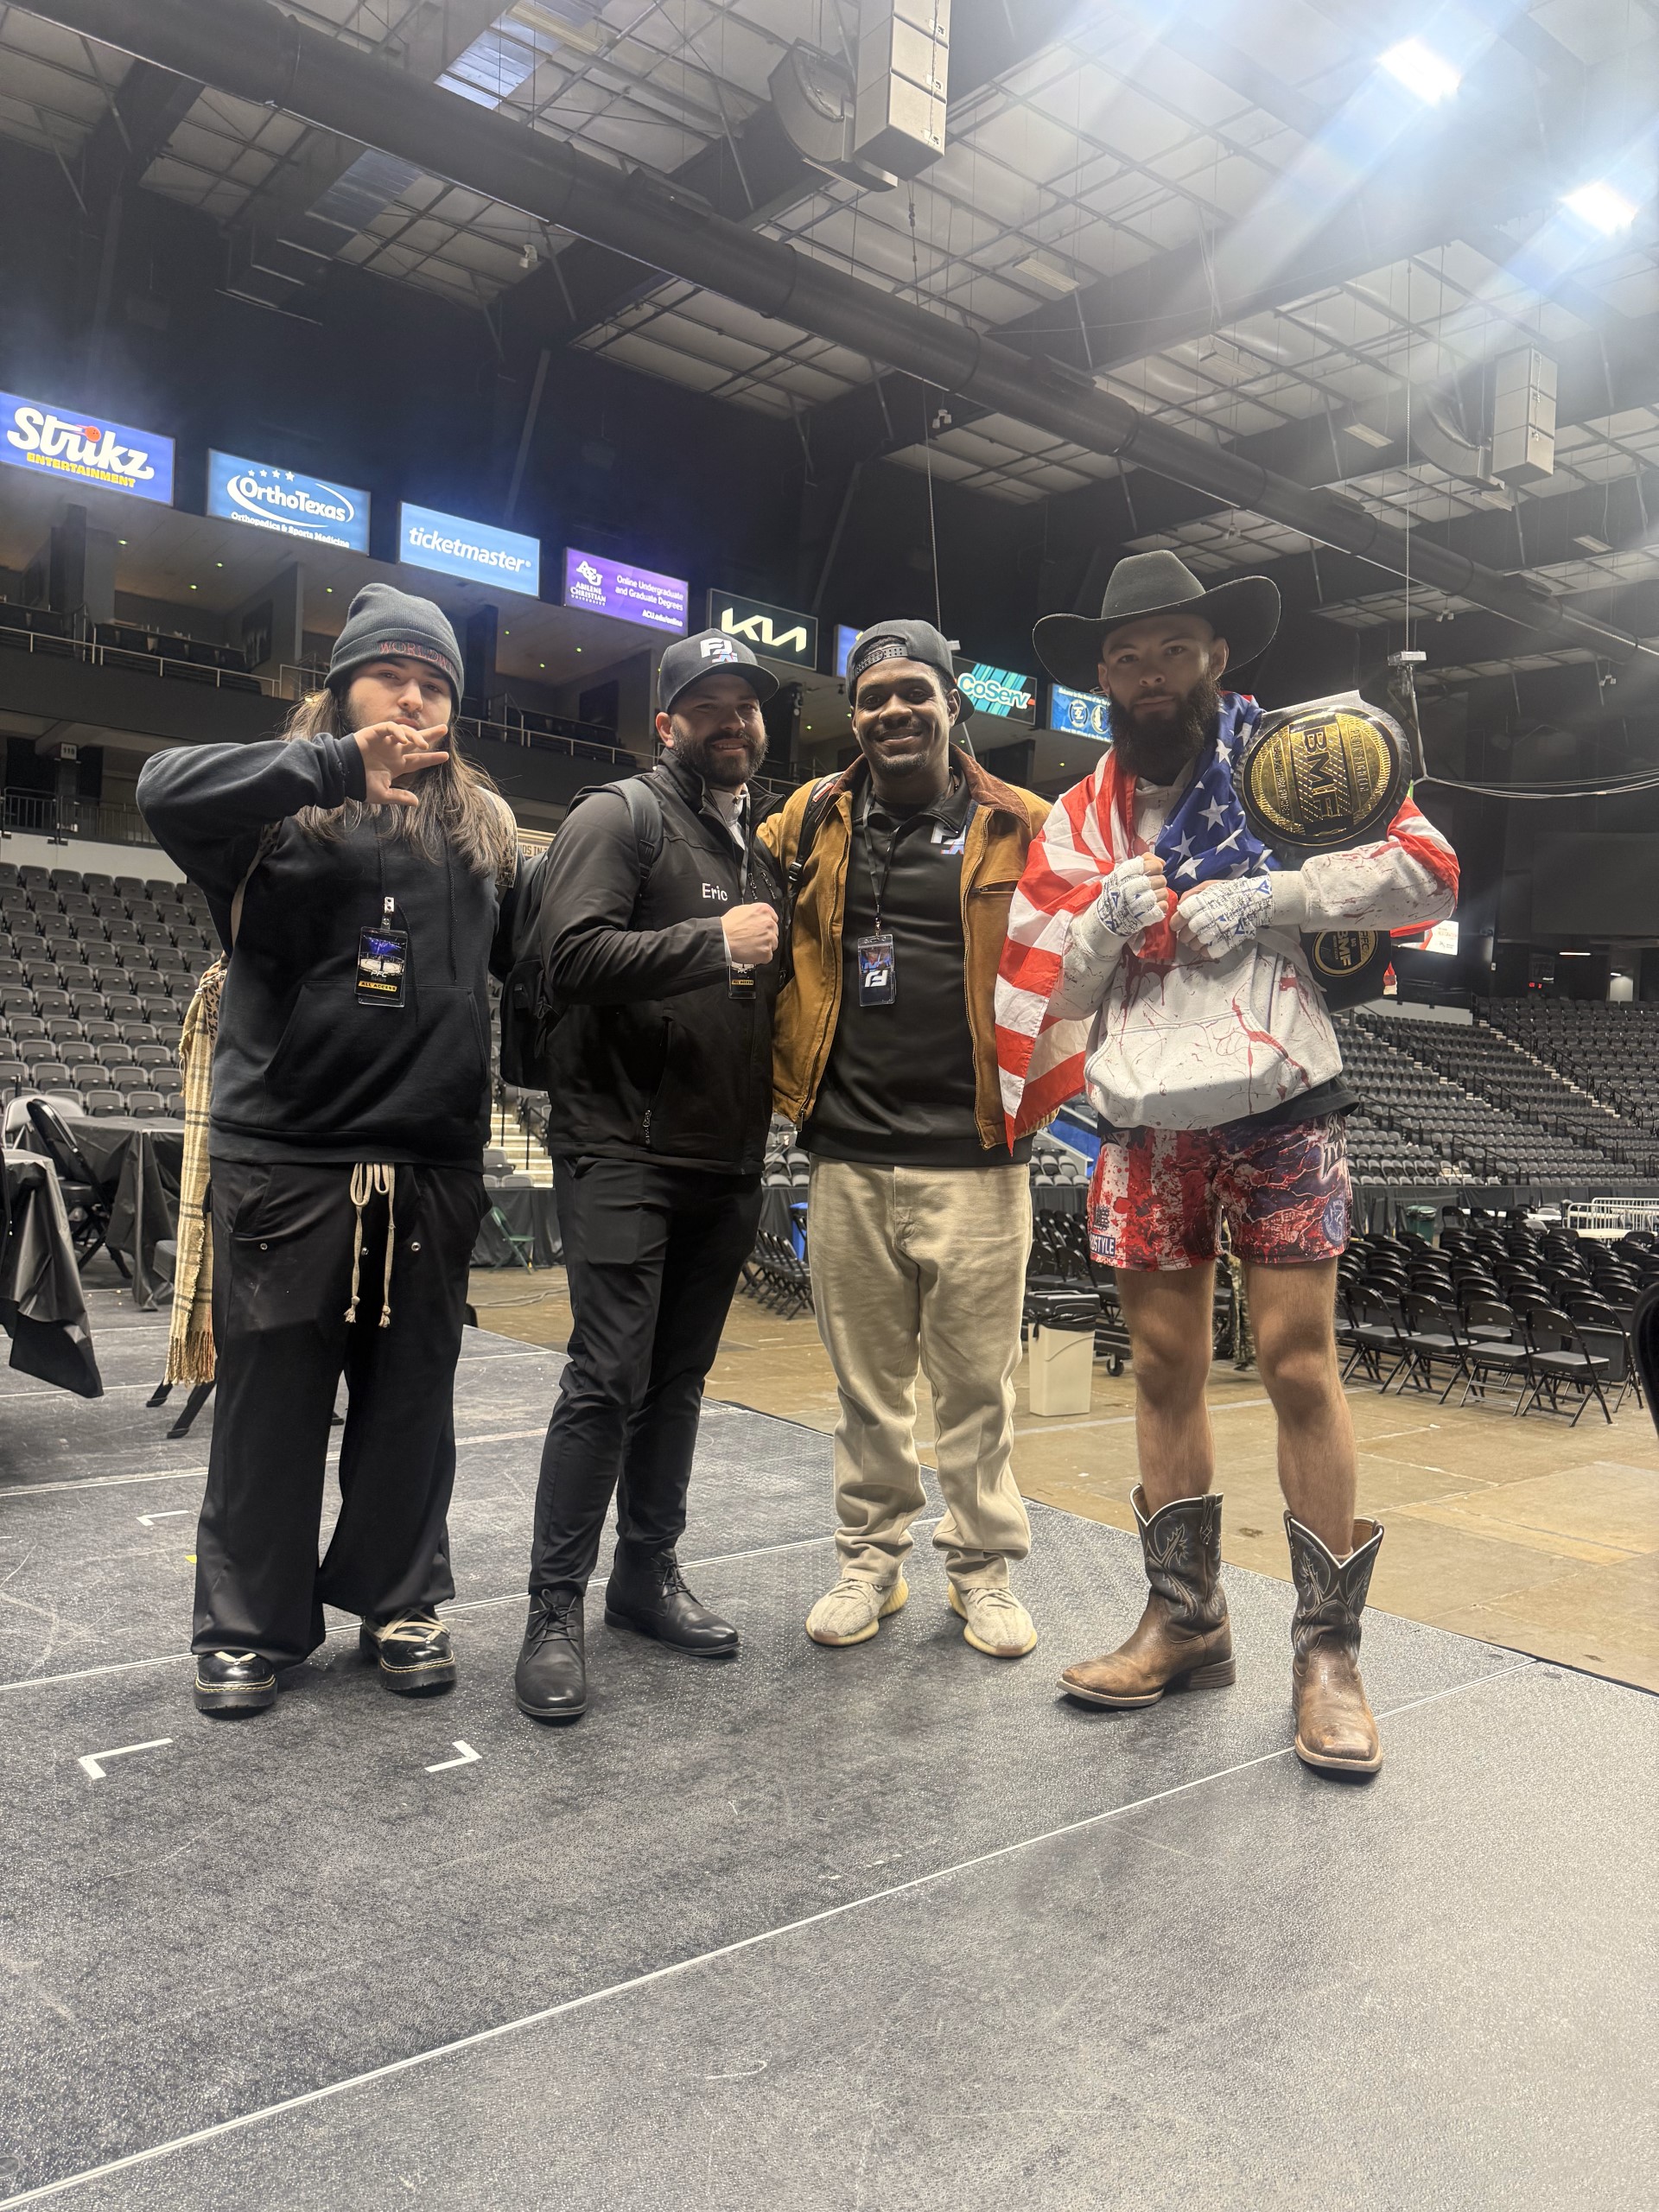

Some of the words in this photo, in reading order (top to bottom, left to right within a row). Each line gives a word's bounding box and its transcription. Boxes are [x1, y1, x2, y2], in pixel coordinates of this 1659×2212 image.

[7, 407, 155, 480] Strikz
[27, 452, 136, 487] ENTERTAINMENT
[239, 477, 346, 522] OrthoTexas
[231, 512, 281, 531] Orthopedics
[289, 525, 314, 541] Sports
[315, 532, 350, 549] Medicine
[570, 586, 607, 603] CHRISTIAN
[575, 582, 602, 595] ABILENE
[615, 586, 628, 596] and
[628, 588, 658, 604] Graduate
[658, 596, 683, 612] Degrees
[616, 575, 638, 588] Online
[639, 580, 684, 601] Undergraduate
[1303, 726, 1339, 817] BMF
[702, 882, 728, 901] Eric
[371, 969, 387, 978] PFC
[373, 982, 396, 991] ACCESS
